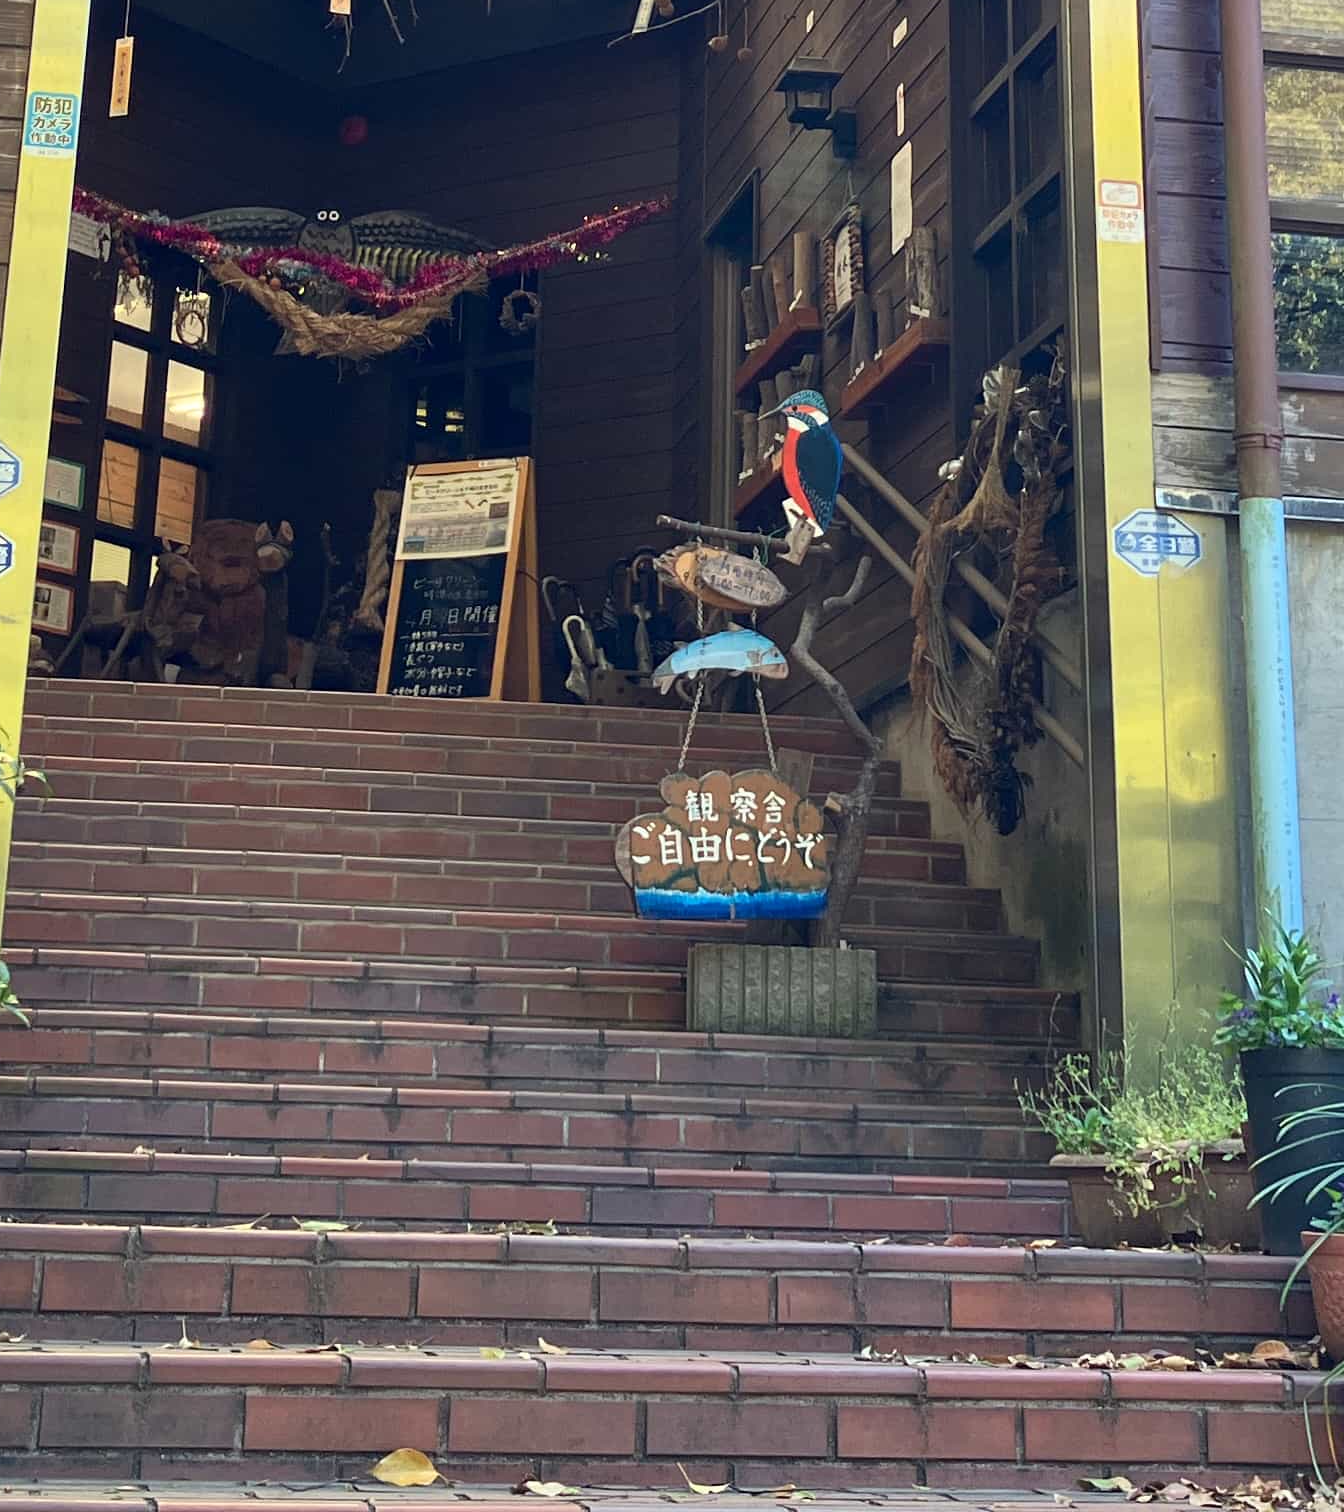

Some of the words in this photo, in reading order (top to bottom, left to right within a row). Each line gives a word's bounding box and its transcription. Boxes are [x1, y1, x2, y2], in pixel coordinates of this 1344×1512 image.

[34, 96, 72, 115] 防犯
[32, 116, 72, 131] カメラ
[30, 131, 71, 145] 作動中
[684, 787, 787, 823] 観察舎
[631, 822, 824, 869] ご自由にどうぞ
